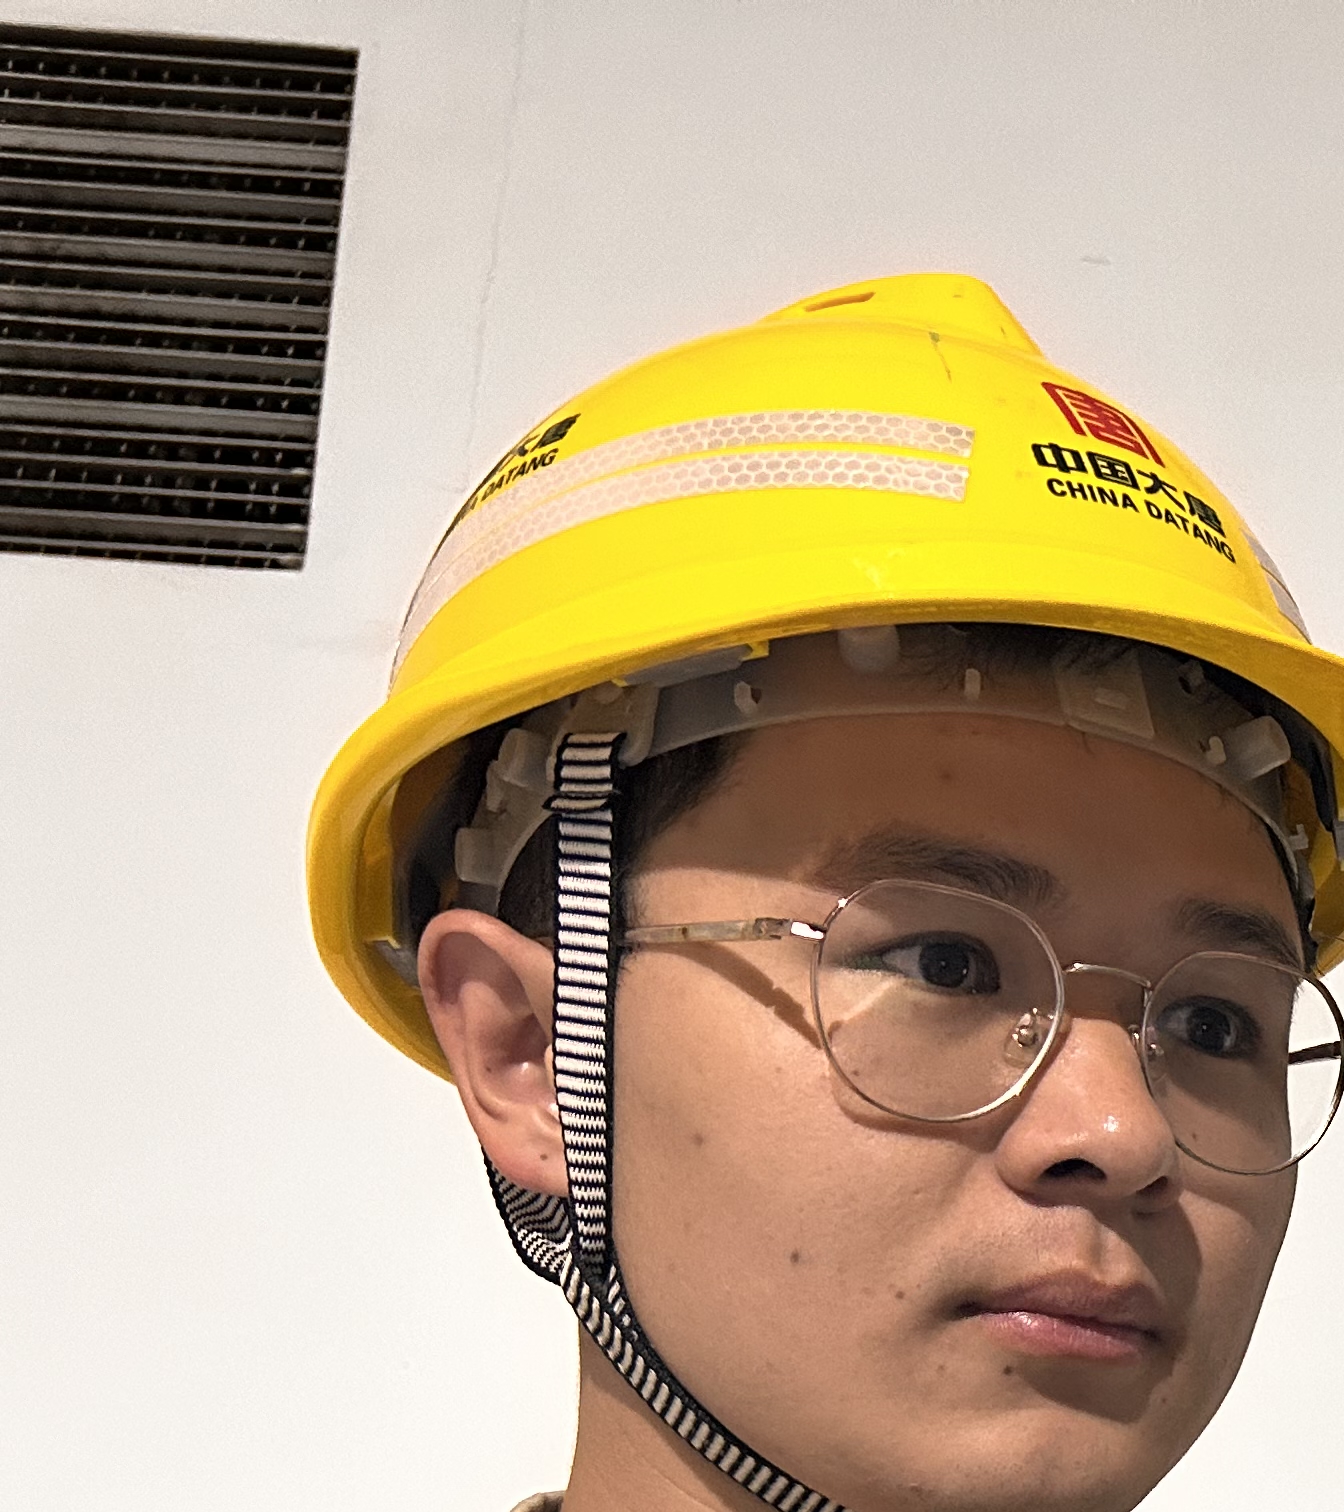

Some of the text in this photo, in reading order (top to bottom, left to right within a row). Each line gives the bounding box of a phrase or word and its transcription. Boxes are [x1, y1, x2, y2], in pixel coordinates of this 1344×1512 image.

[481, 448, 559, 502] DATANG
[1046, 478, 1236, 563] CHINA DATANG
